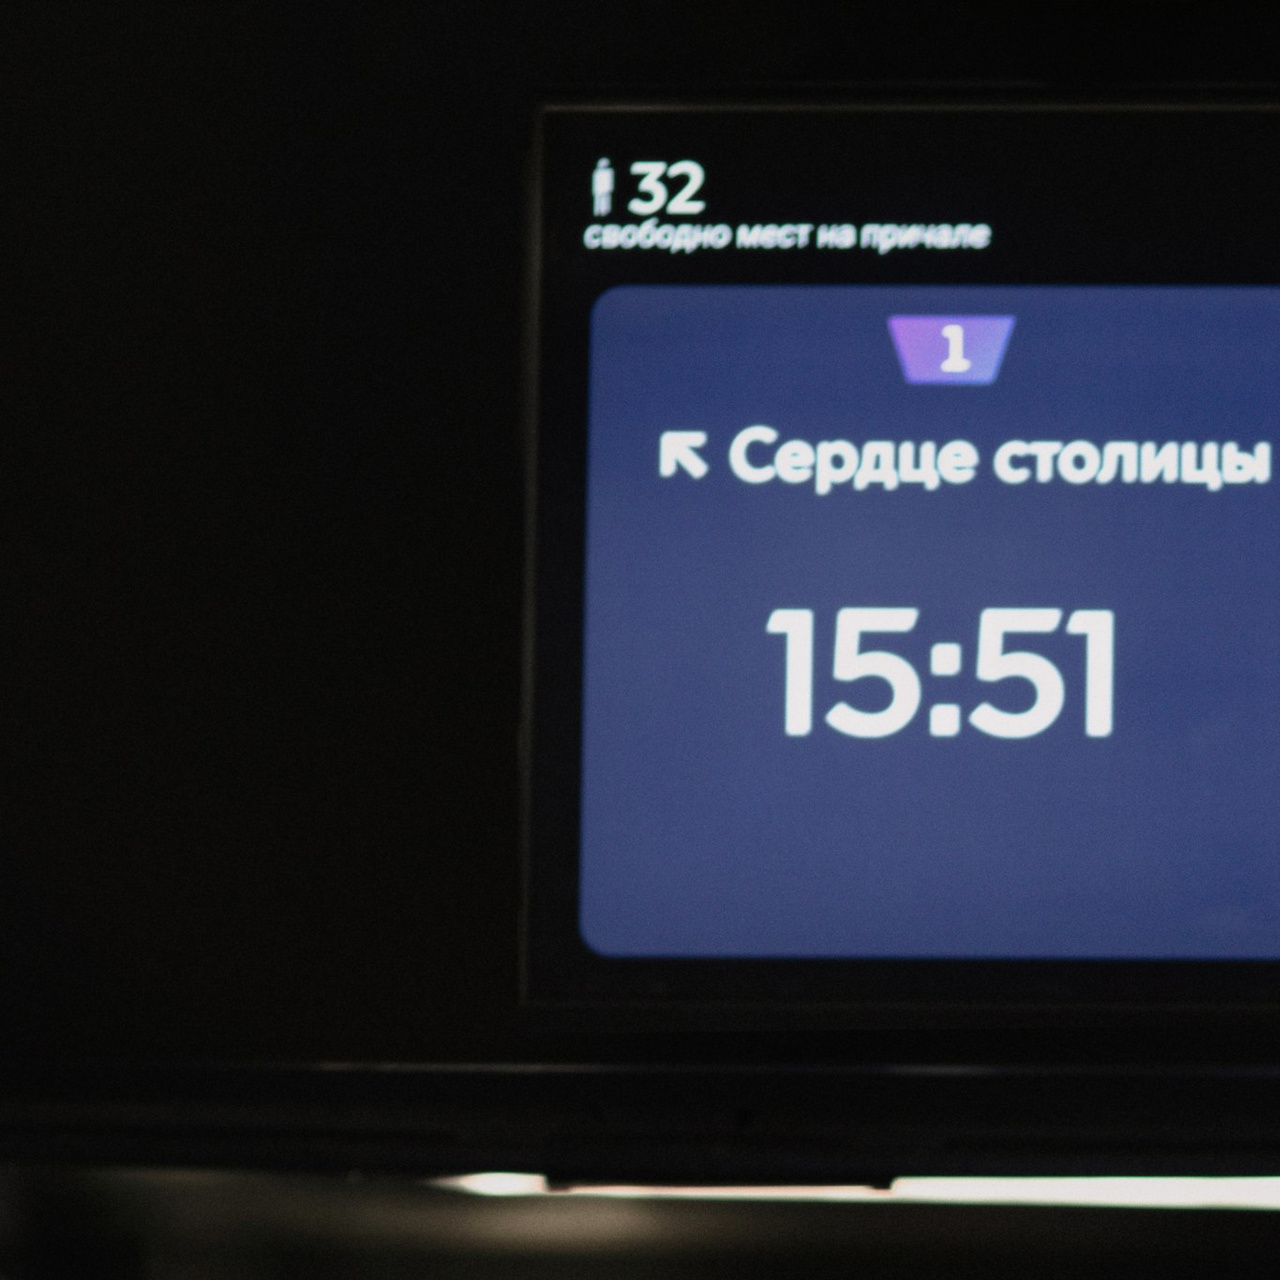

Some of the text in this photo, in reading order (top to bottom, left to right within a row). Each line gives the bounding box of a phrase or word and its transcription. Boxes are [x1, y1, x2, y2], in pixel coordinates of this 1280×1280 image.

[628, 159, 706, 216] 32
[583, 217, 992, 256] свободно мест на причале
[939, 324, 972, 373] 1
[728, 425, 1272, 496] Сердце столицы
[765, 607, 1115, 739] 15:51
